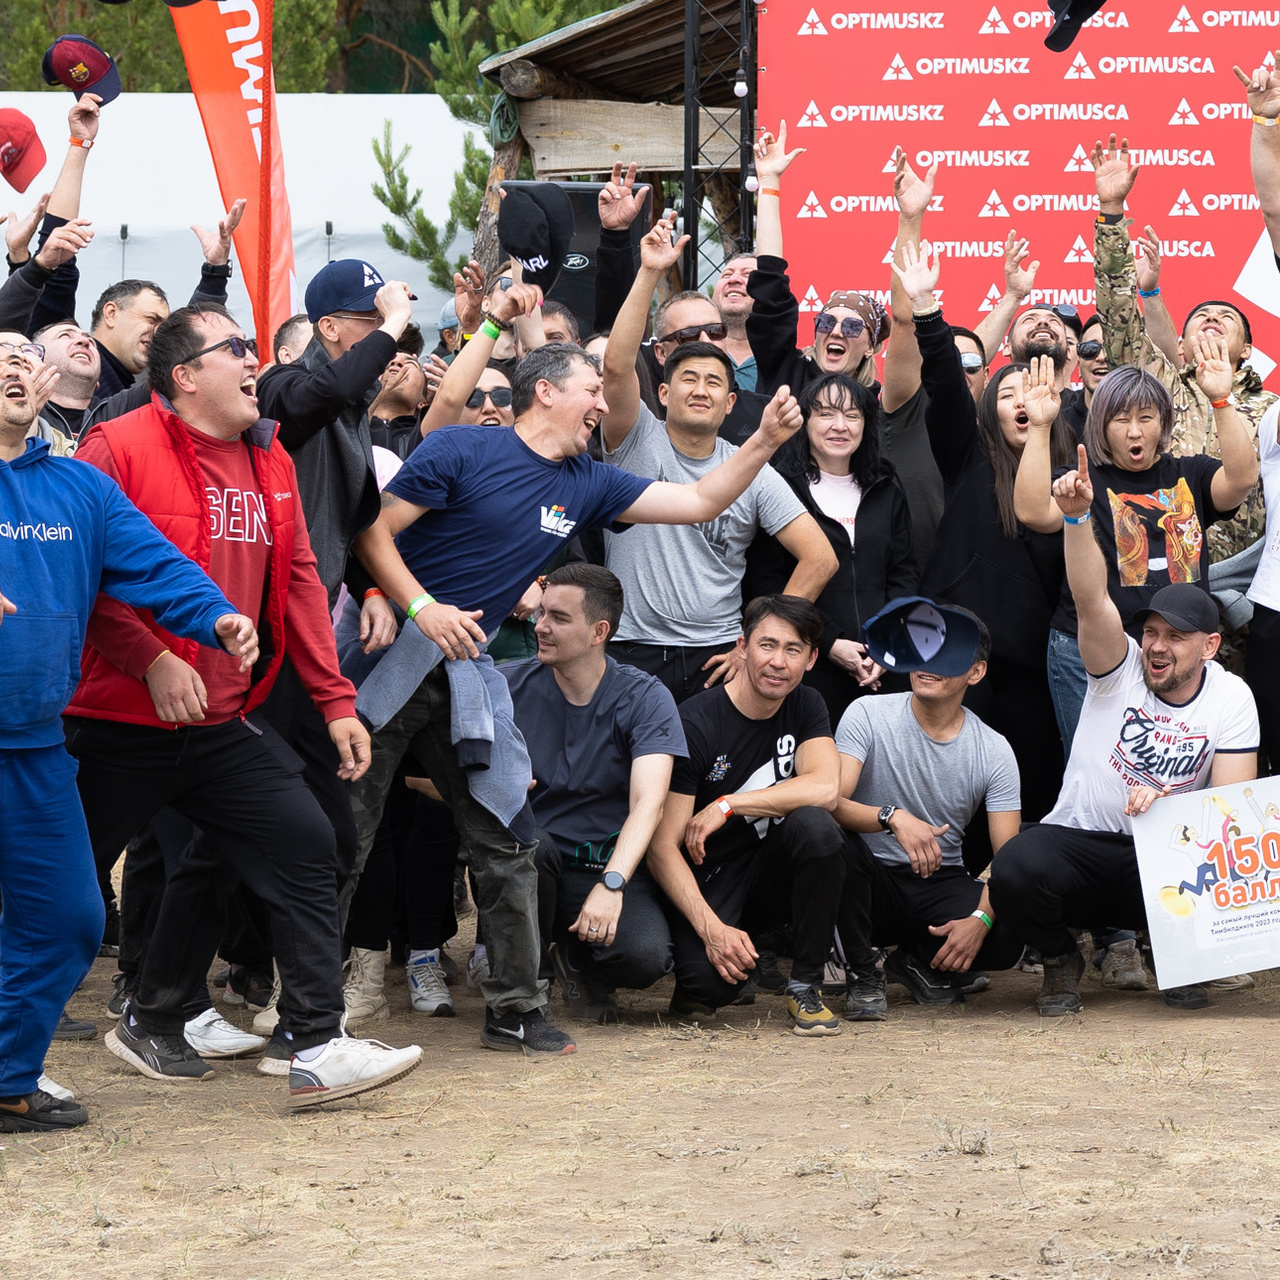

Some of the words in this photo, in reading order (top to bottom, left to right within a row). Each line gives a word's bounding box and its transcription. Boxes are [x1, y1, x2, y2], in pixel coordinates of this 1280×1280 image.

[830, 12, 945, 30] OPTIMUSKZ
[915, 57, 1030, 75] OPTIMUSKZ
[1098, 55, 1216, 74] OPTIMUSCA
[830, 104, 945, 122] OPTIMUSKZ
[1012, 103, 1130, 121] OPTIMUSCA
[915, 150, 1030, 167] OPTIMUSKZ
[1255, 918, 1271, 927] 2023
